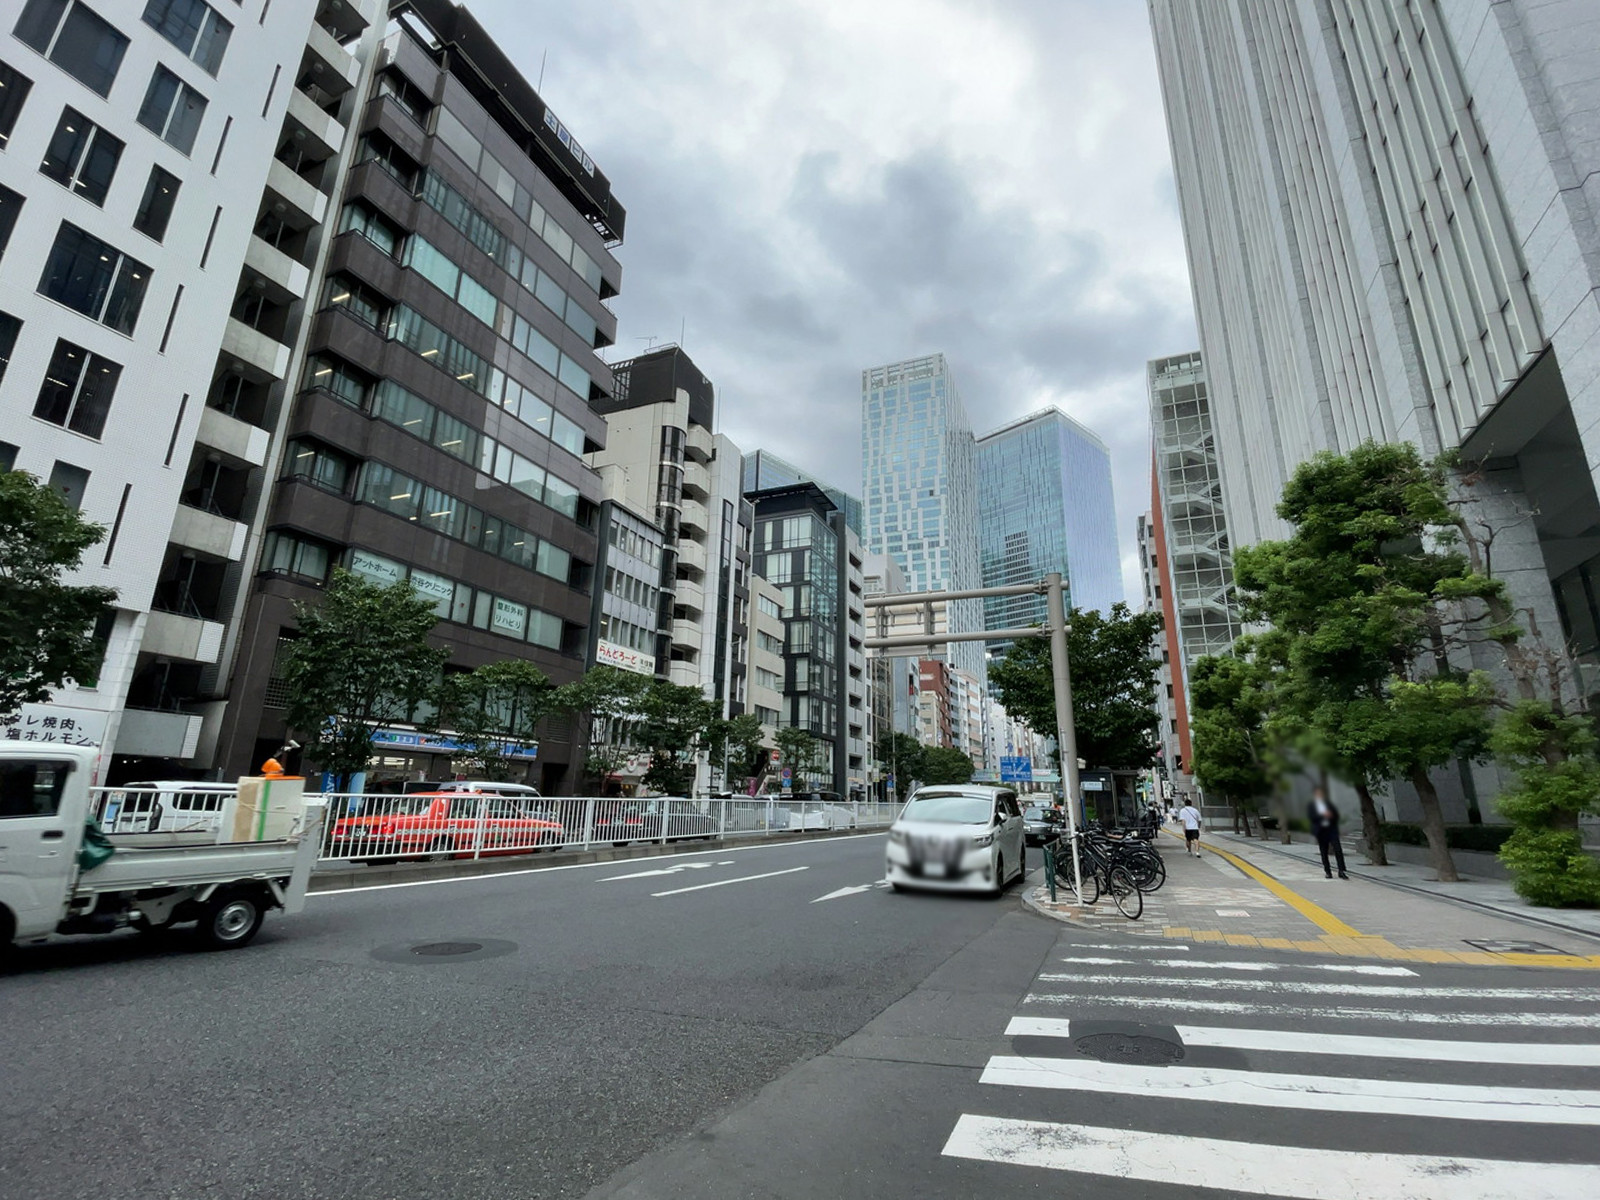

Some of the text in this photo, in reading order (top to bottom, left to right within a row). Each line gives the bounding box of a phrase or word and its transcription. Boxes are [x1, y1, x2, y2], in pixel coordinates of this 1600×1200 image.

[352, 556, 397, 577] アットホーム
